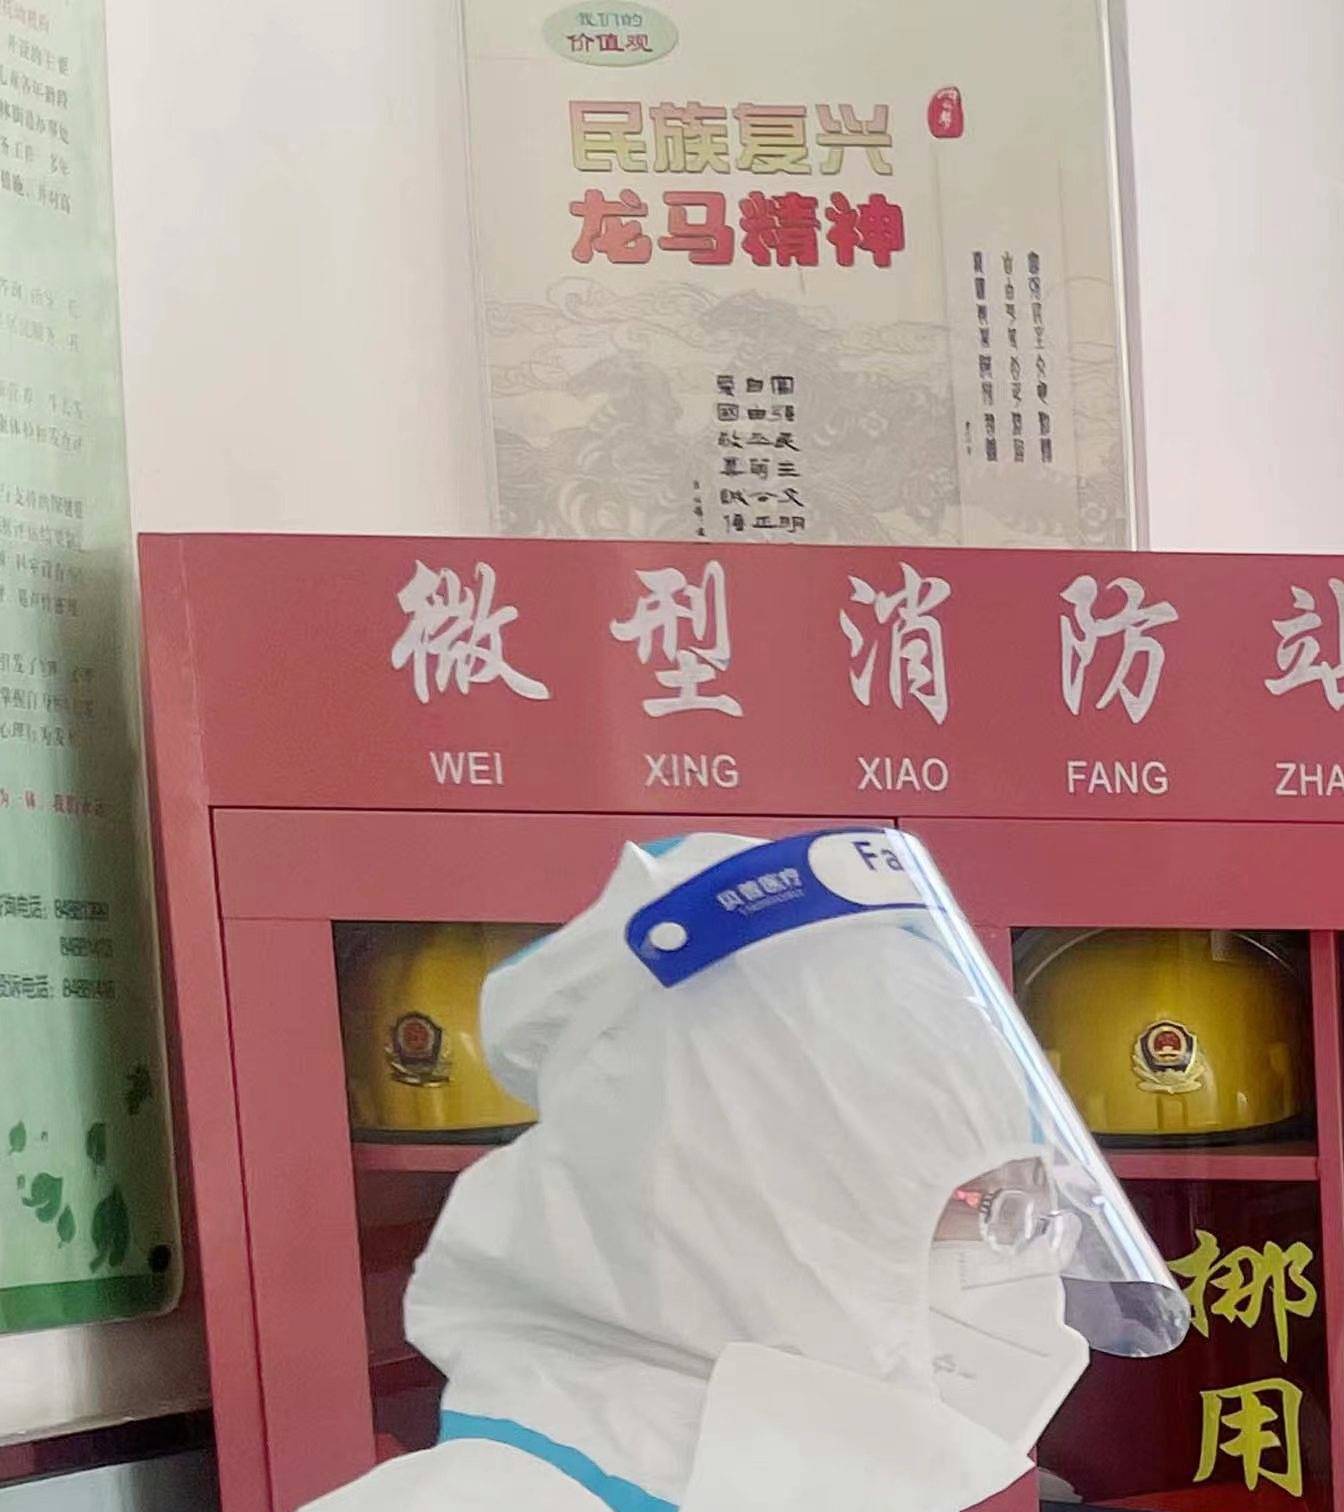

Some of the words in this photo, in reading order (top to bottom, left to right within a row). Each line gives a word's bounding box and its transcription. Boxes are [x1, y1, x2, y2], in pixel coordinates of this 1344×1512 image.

[567, 33, 653, 53] 价值观
[570, 101, 892, 174] 民族复兴
[569, 188, 905, 267] 龙马精神
[429, 750, 505, 786] WEI
[643, 753, 740, 789] XING
[857, 756, 949, 793] XIAO
[1067, 760, 1168, 795] FANG
